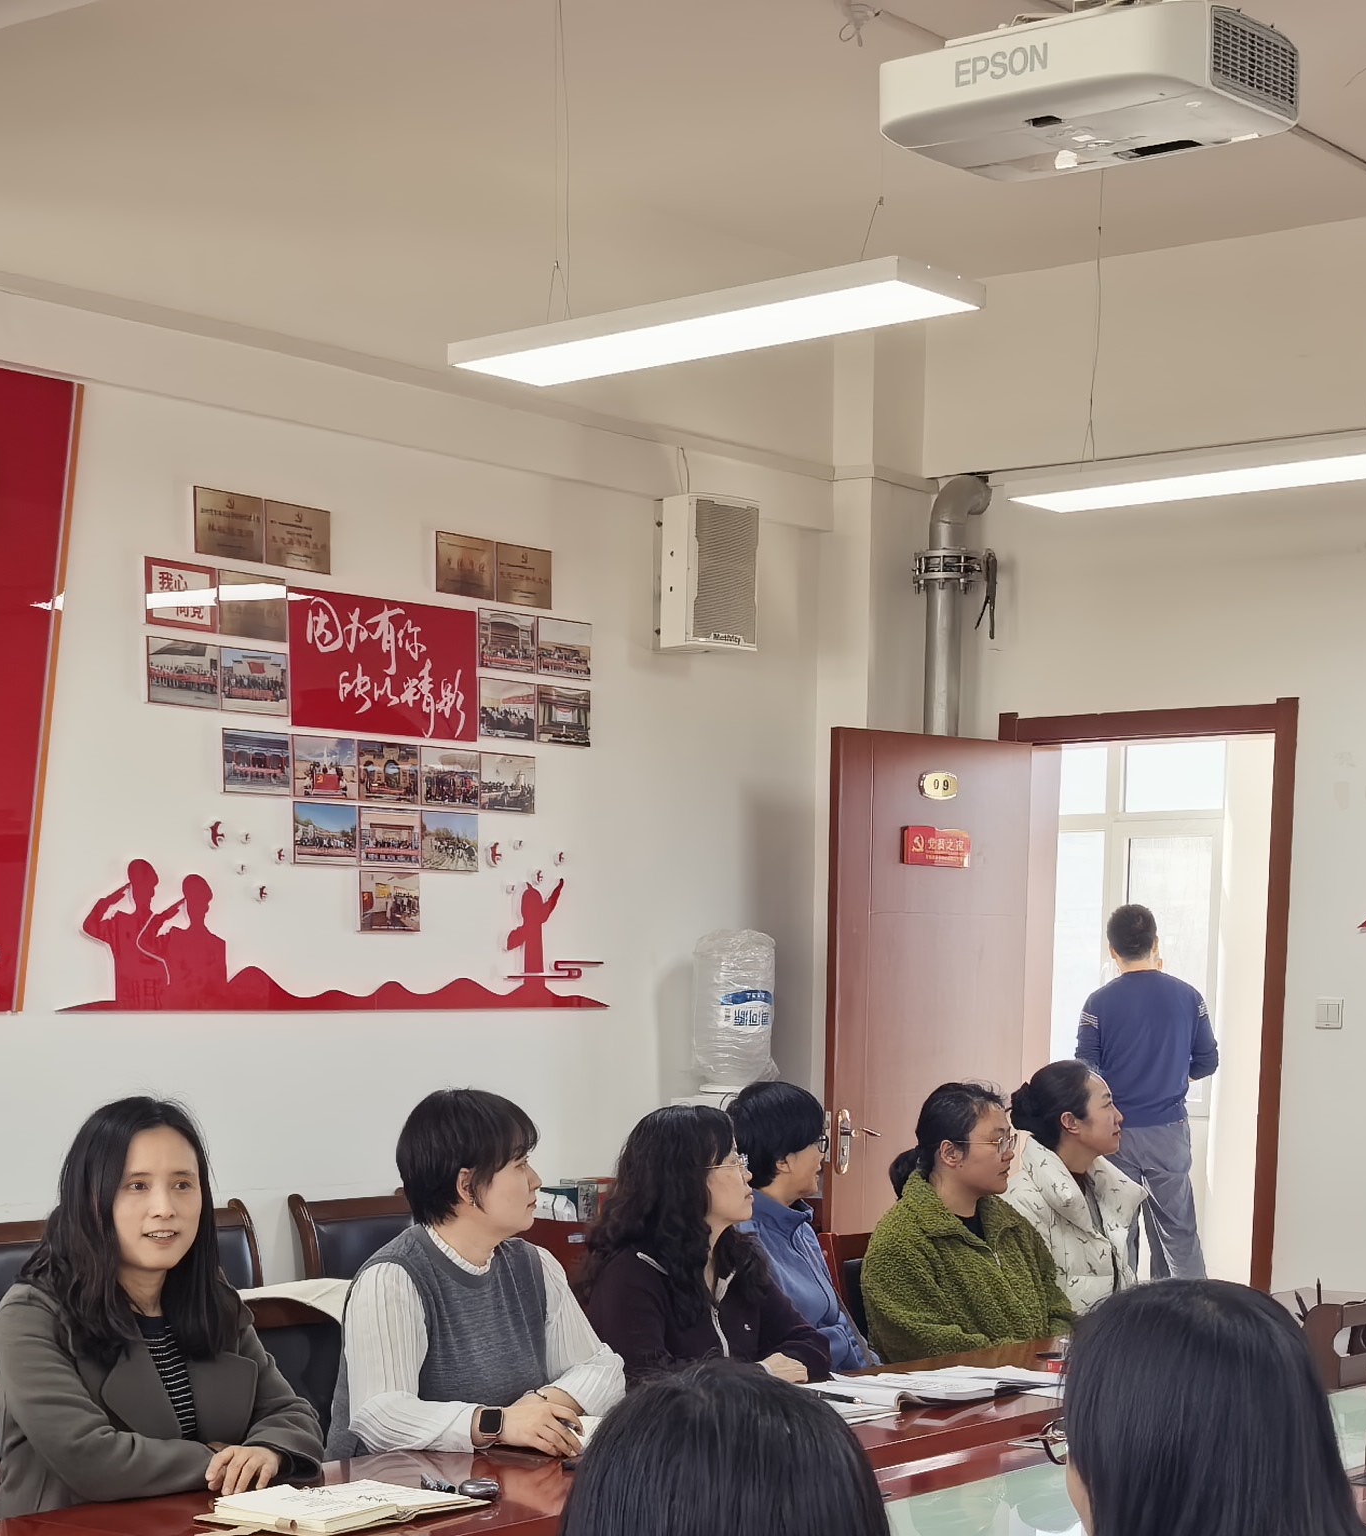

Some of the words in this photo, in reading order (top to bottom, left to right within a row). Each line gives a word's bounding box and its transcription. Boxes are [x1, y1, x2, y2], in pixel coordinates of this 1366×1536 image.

[954, 42, 1048, 88] EPSON
[306, 597, 427, 675] 因为有你
